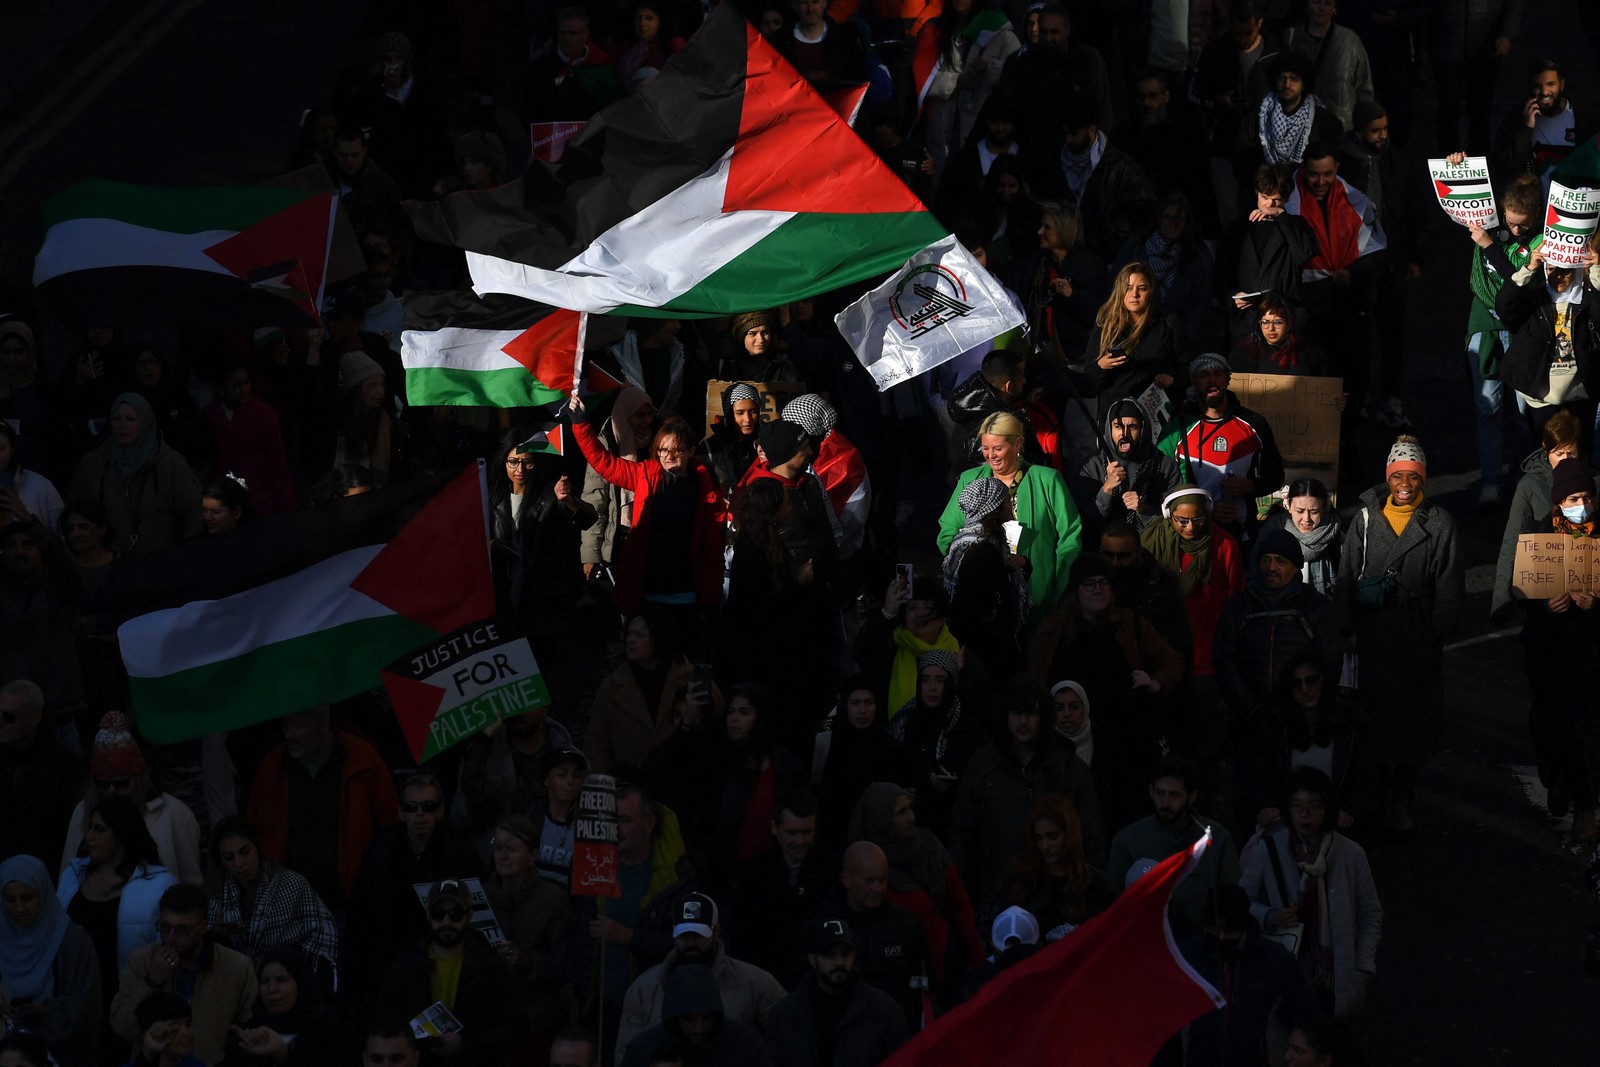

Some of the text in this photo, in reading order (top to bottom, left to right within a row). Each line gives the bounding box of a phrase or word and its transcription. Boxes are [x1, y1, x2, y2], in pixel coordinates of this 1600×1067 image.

[1432, 168, 1487, 178] PALESTINE
[1440, 198, 1492, 209] BOYCOTT
[1549, 193, 1600, 211] PALESTINE
[1562, 189, 1588, 202] FREE
[1231, 377, 1335, 408] TOP THE
[1519, 540, 1599, 552] THE ONLY LASTIN
[1531, 555, 1564, 563] PEACE
[1519, 569, 1600, 586] FREE PALES
[411, 623, 500, 676] JUSTICE
[452, 653, 518, 697] FOR
[429, 678, 542, 751] PALESTINE
